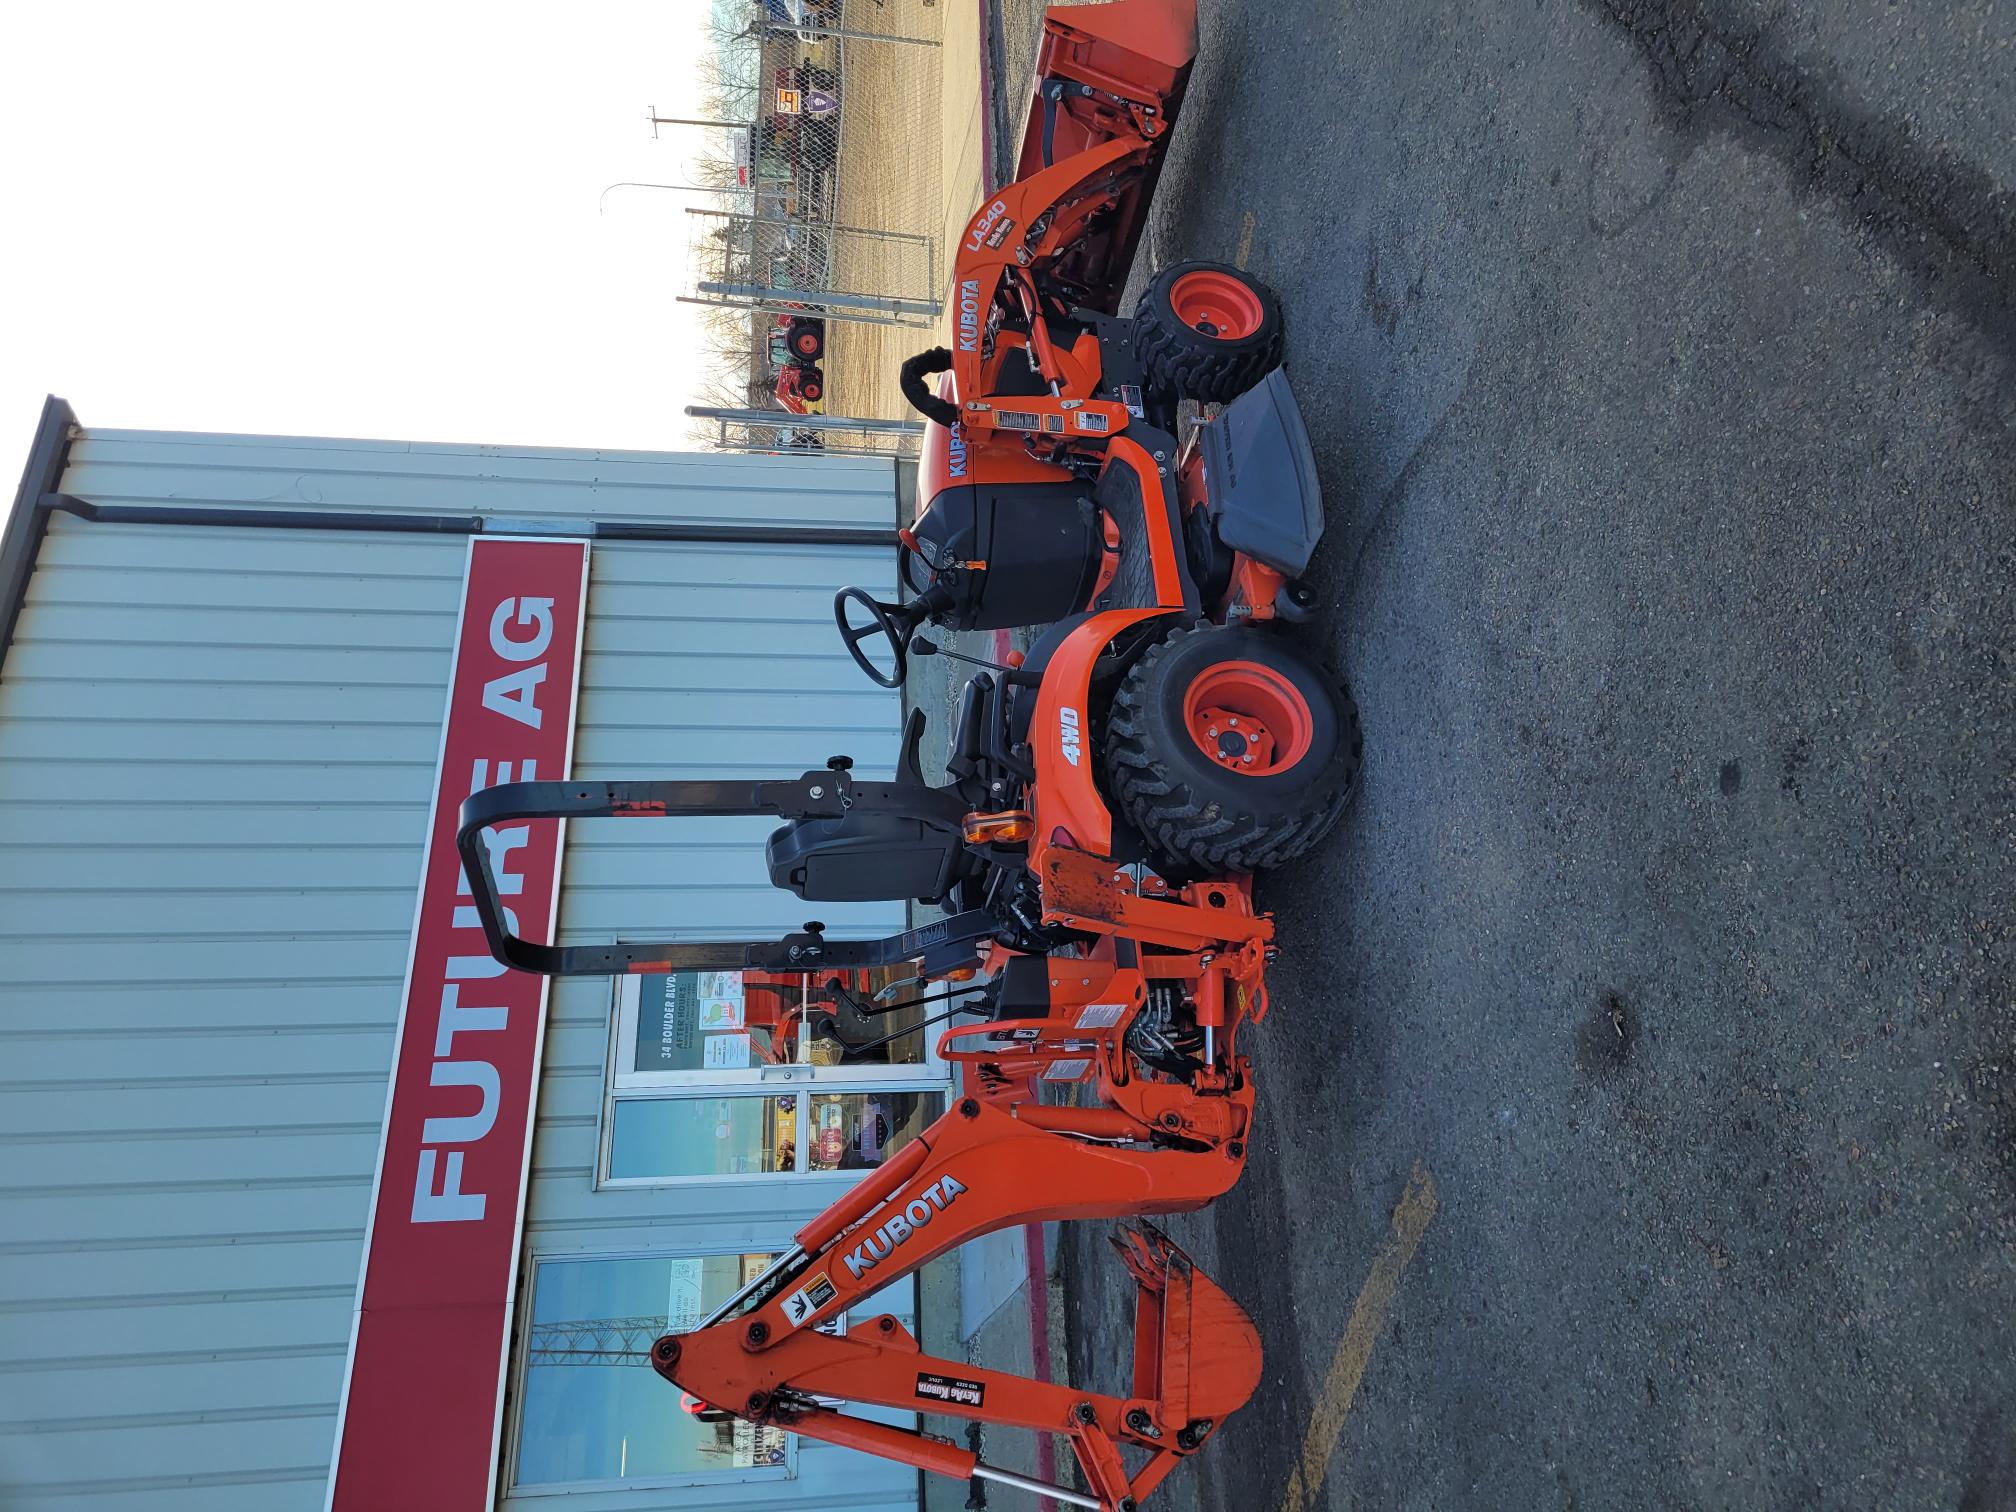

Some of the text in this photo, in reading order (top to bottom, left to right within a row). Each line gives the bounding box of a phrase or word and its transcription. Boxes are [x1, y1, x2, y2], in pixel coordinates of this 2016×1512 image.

[966, 200, 1007, 252] LA340
[959, 280, 979, 352] KUBOTA
[481, 596, 555, 730] AG
[1060, 706, 1080, 766] 4WD
[662, 1002, 674, 1044] BOULDER
[676, 1019, 684, 1048] AFTER
[661, 1046, 671, 1058] 34
[843, 1174, 968, 1280] KUBOTA
